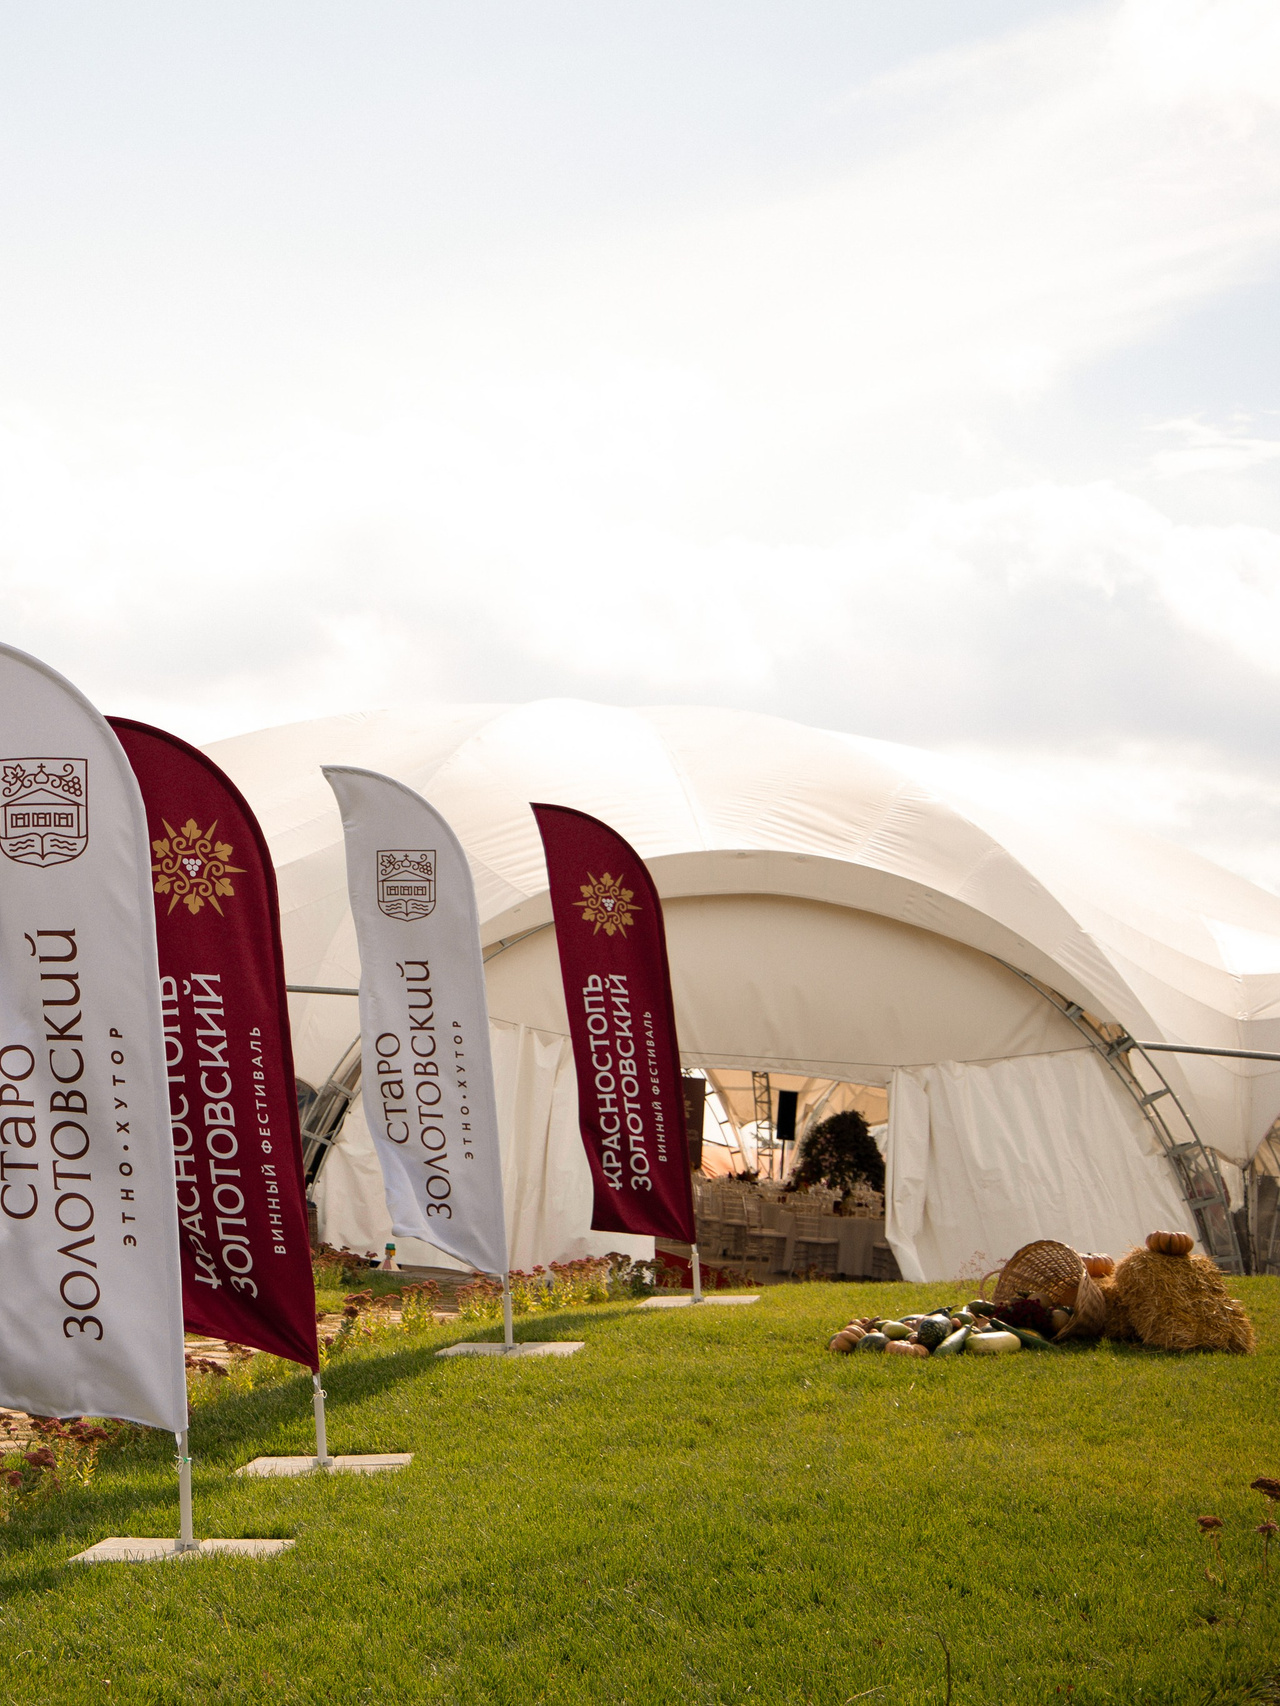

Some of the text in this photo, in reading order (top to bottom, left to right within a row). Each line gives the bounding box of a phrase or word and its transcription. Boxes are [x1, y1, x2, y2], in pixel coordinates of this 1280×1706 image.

[182, 972, 258, 1298] ЗОЛОТОВСКИЙ
[250, 1026, 286, 1255] ВИННЫЙ ФЕСТИВАЛЬ
[584, 974, 623, 1190] КРАСНОСТОПЪ
[604, 974, 652, 1191] ЗОЛОТОВСКИЙ
[641, 1011, 668, 1162] ВИННЫЙ ФЕСТИВАЛЬ
